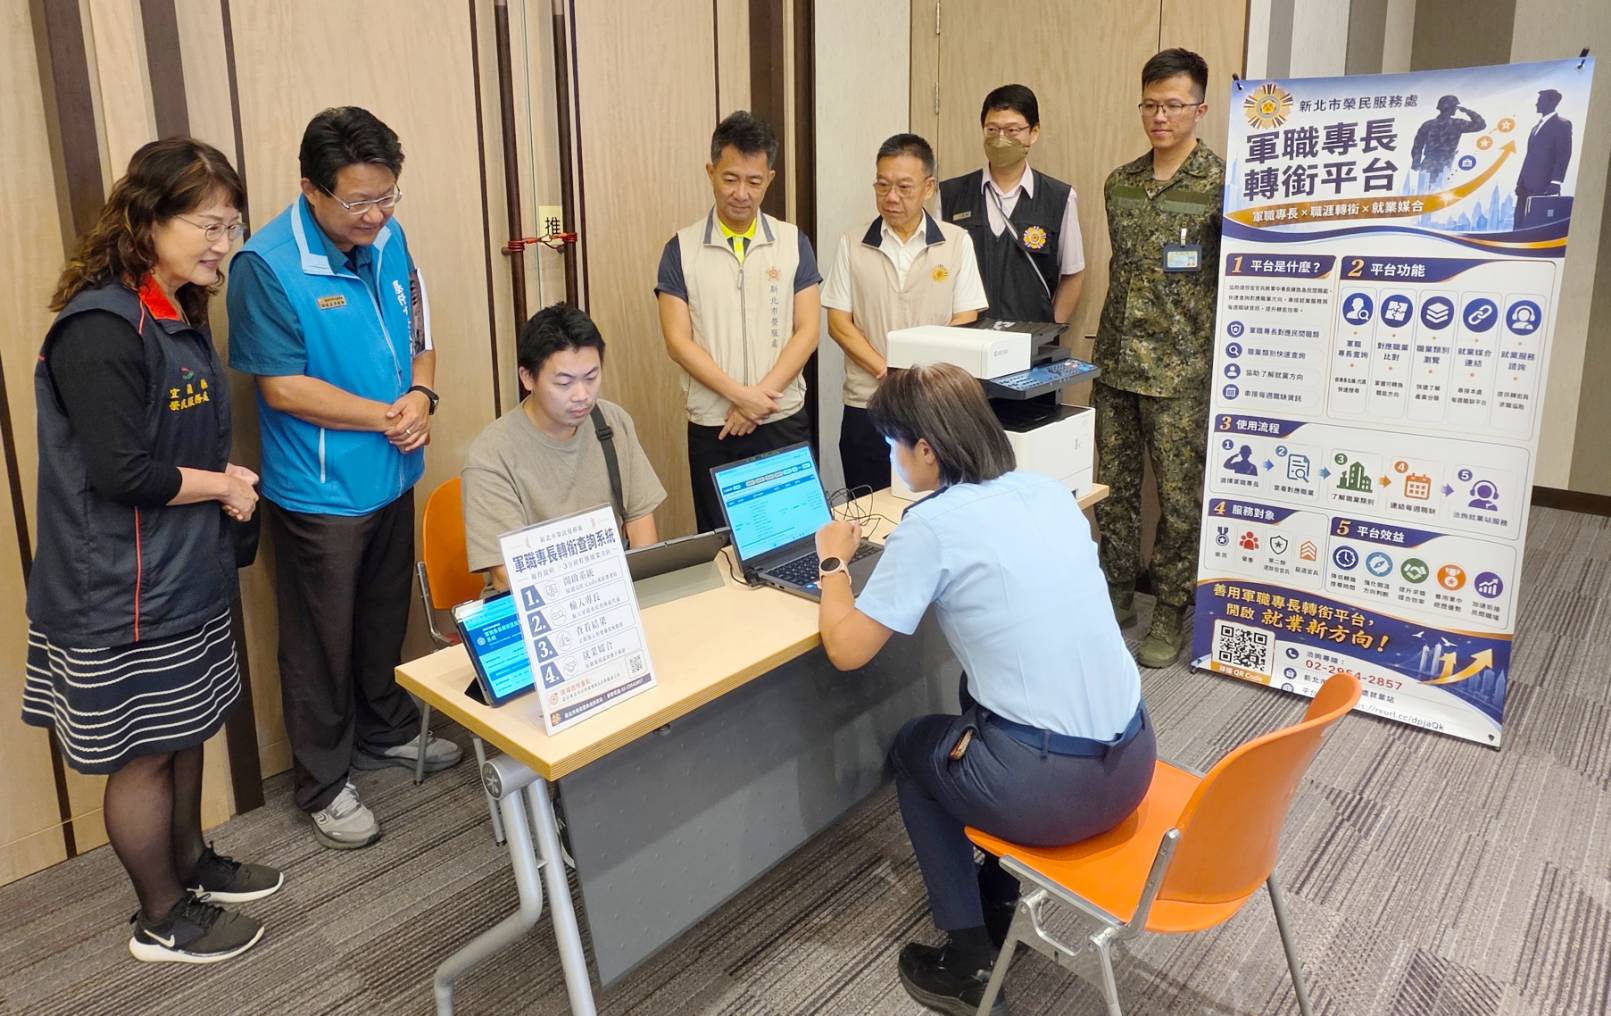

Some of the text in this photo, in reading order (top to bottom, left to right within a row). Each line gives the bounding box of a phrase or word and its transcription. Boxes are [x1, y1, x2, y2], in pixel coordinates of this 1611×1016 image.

[1299, 94, 1418, 113] 新北市榮民服務處
[1245, 118, 1398, 164] 軍職專長
[1243, 158, 1398, 201] 轉銜平台
[545, 217, 560, 235] 推
[1231, 256, 1243, 273] 1
[1348, 259, 1426, 277] 2 平台功能
[1220, 416, 1280, 434] 3 使用流程
[1214, 501, 1275, 521] 4 服務對象
[1336, 520, 1405, 543] 5 平台效益
[512, 528, 616, 573] 軍職專長轉銜查詢系統
[526, 590, 540, 606] 1.
[1226, 603, 1255, 621] 開啟
[532, 615, 546, 632] 2.
[538, 641, 553, 658] 3.
[545, 666, 559, 682] 4.
